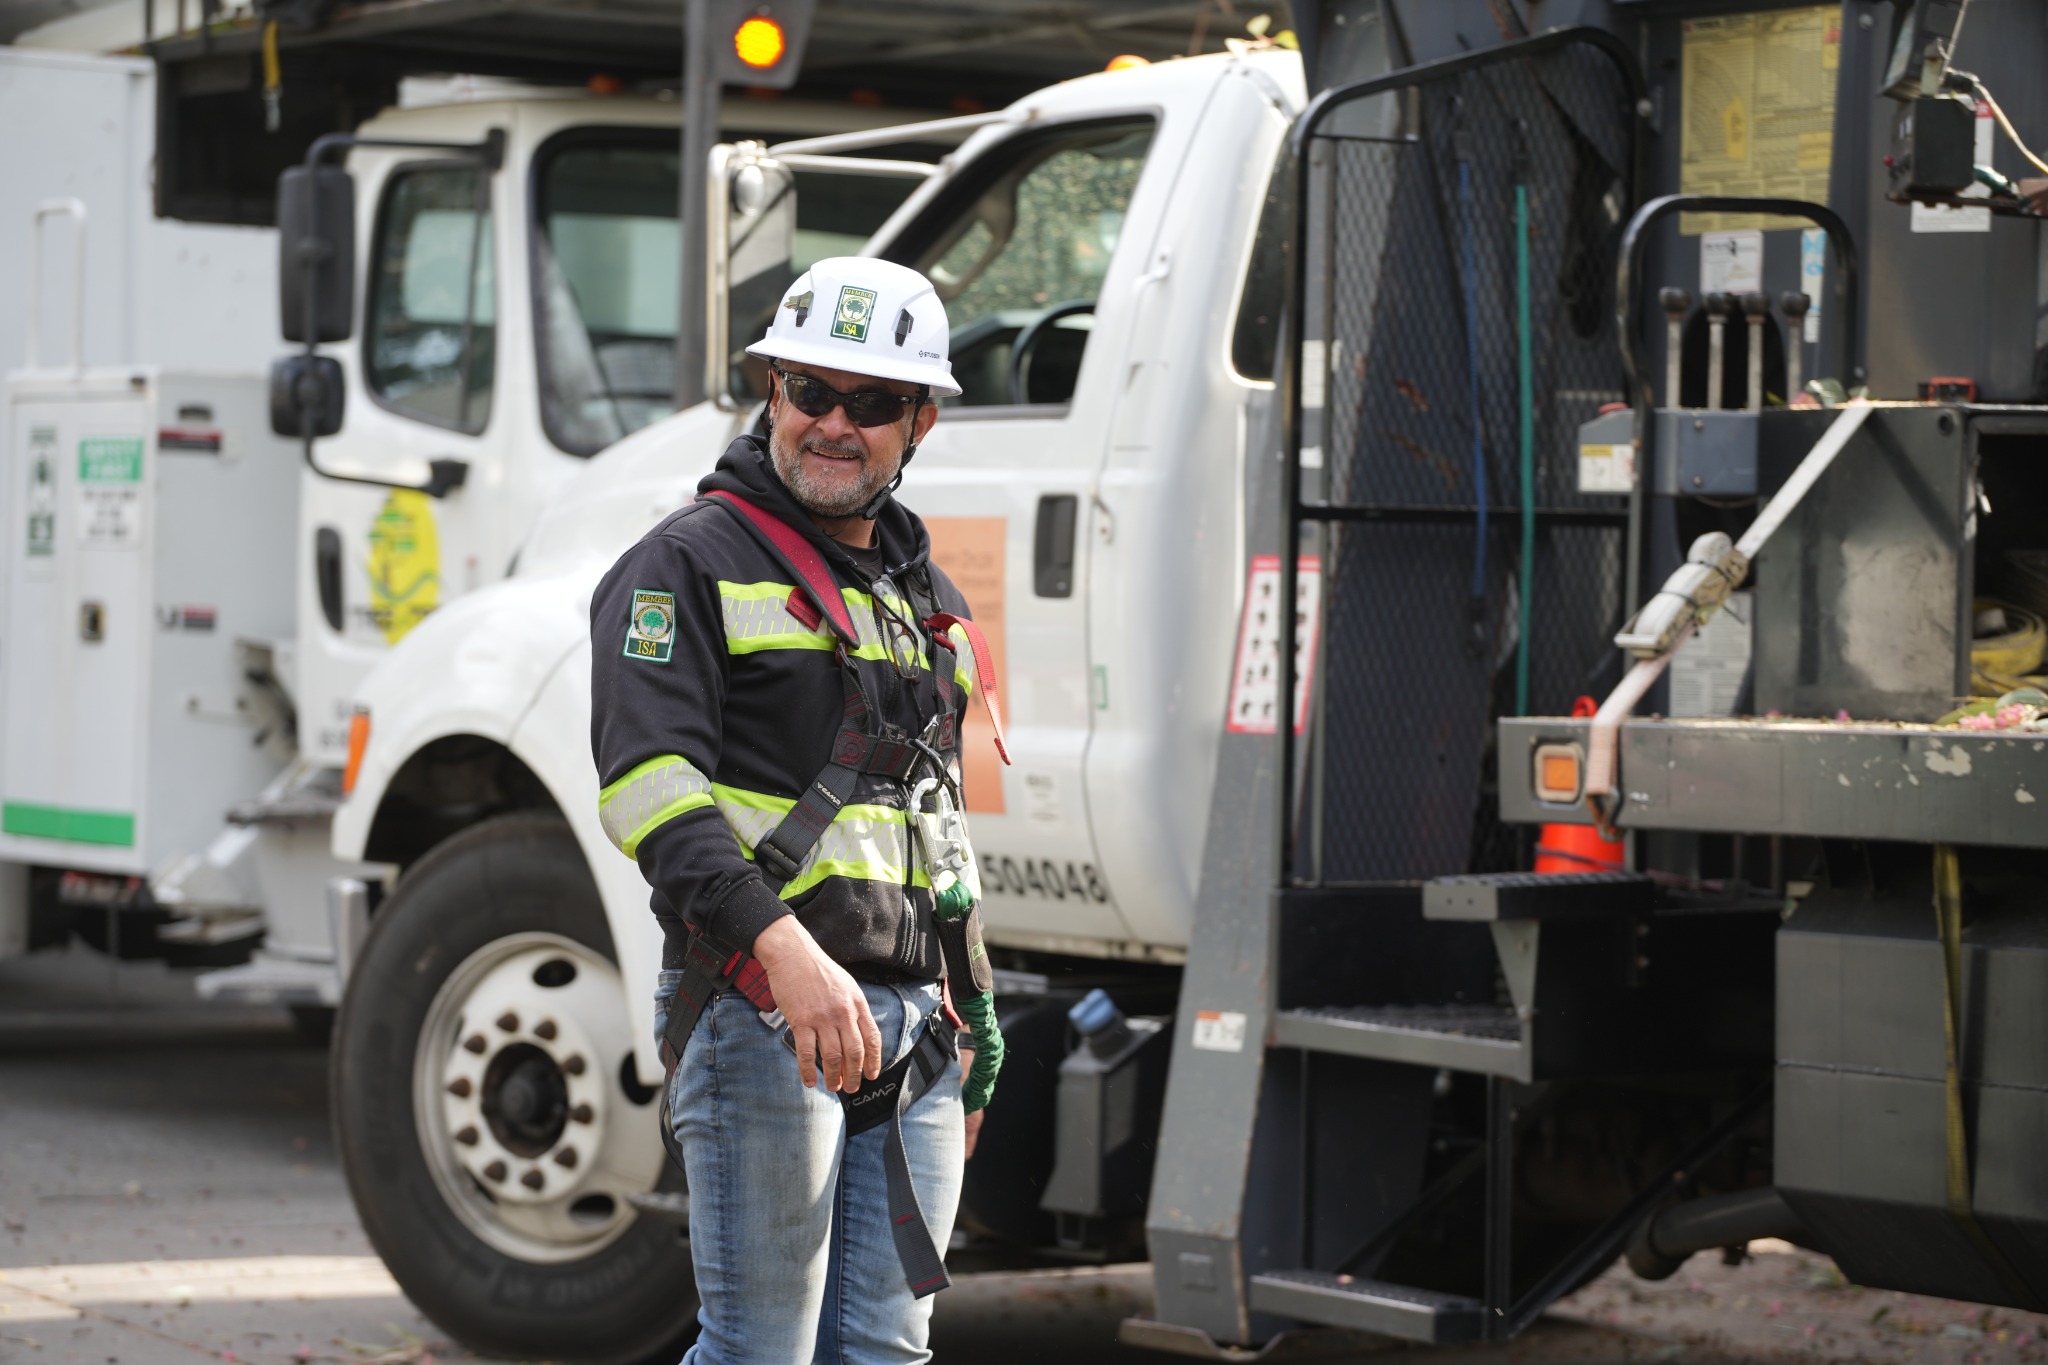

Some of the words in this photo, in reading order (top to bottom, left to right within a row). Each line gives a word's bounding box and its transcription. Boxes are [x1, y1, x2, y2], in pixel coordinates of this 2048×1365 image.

[844, 289, 873, 299] MEMBER
[842, 323, 858, 336] ISA
[637, 594, 673, 604] MEMBER
[636, 640, 657, 657] ISA
[821, 787, 841, 806] CAMP
[852, 1083, 896, 1106] CAMP
